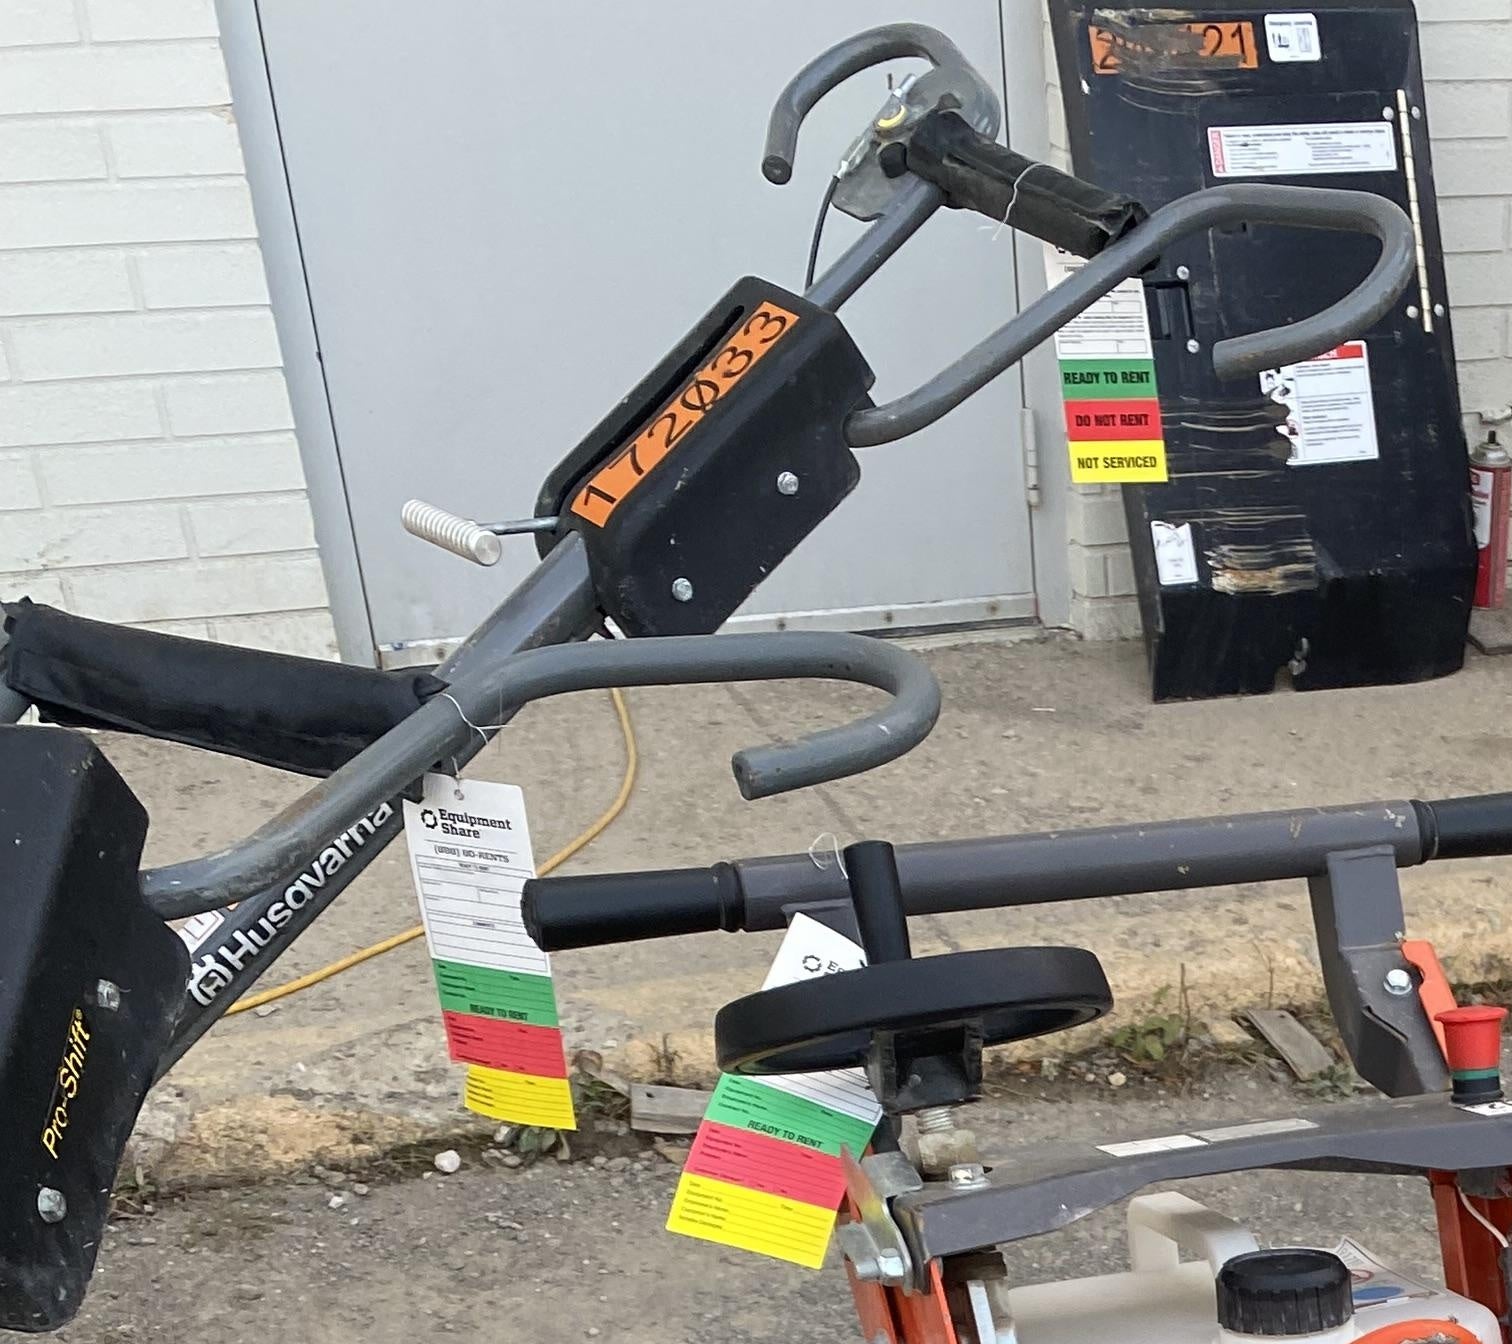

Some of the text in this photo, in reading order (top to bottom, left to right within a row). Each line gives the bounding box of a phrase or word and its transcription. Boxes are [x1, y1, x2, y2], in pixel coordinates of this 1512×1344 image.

[1063, 371, 1150, 384] READY TO RENT
[583, 310, 787, 507] 172033
[1075, 413, 1149, 426] DO NOT RENT
[1077, 456, 1157, 469] NOT SERVICED
[438, 808, 512, 830] Equipment
[441, 822, 480, 839] Share
[218, 801, 394, 971] Husqvarna
[469, 1003, 529, 1021] READY TO RENT
[747, 1119, 825, 1149] READY TO RENT
